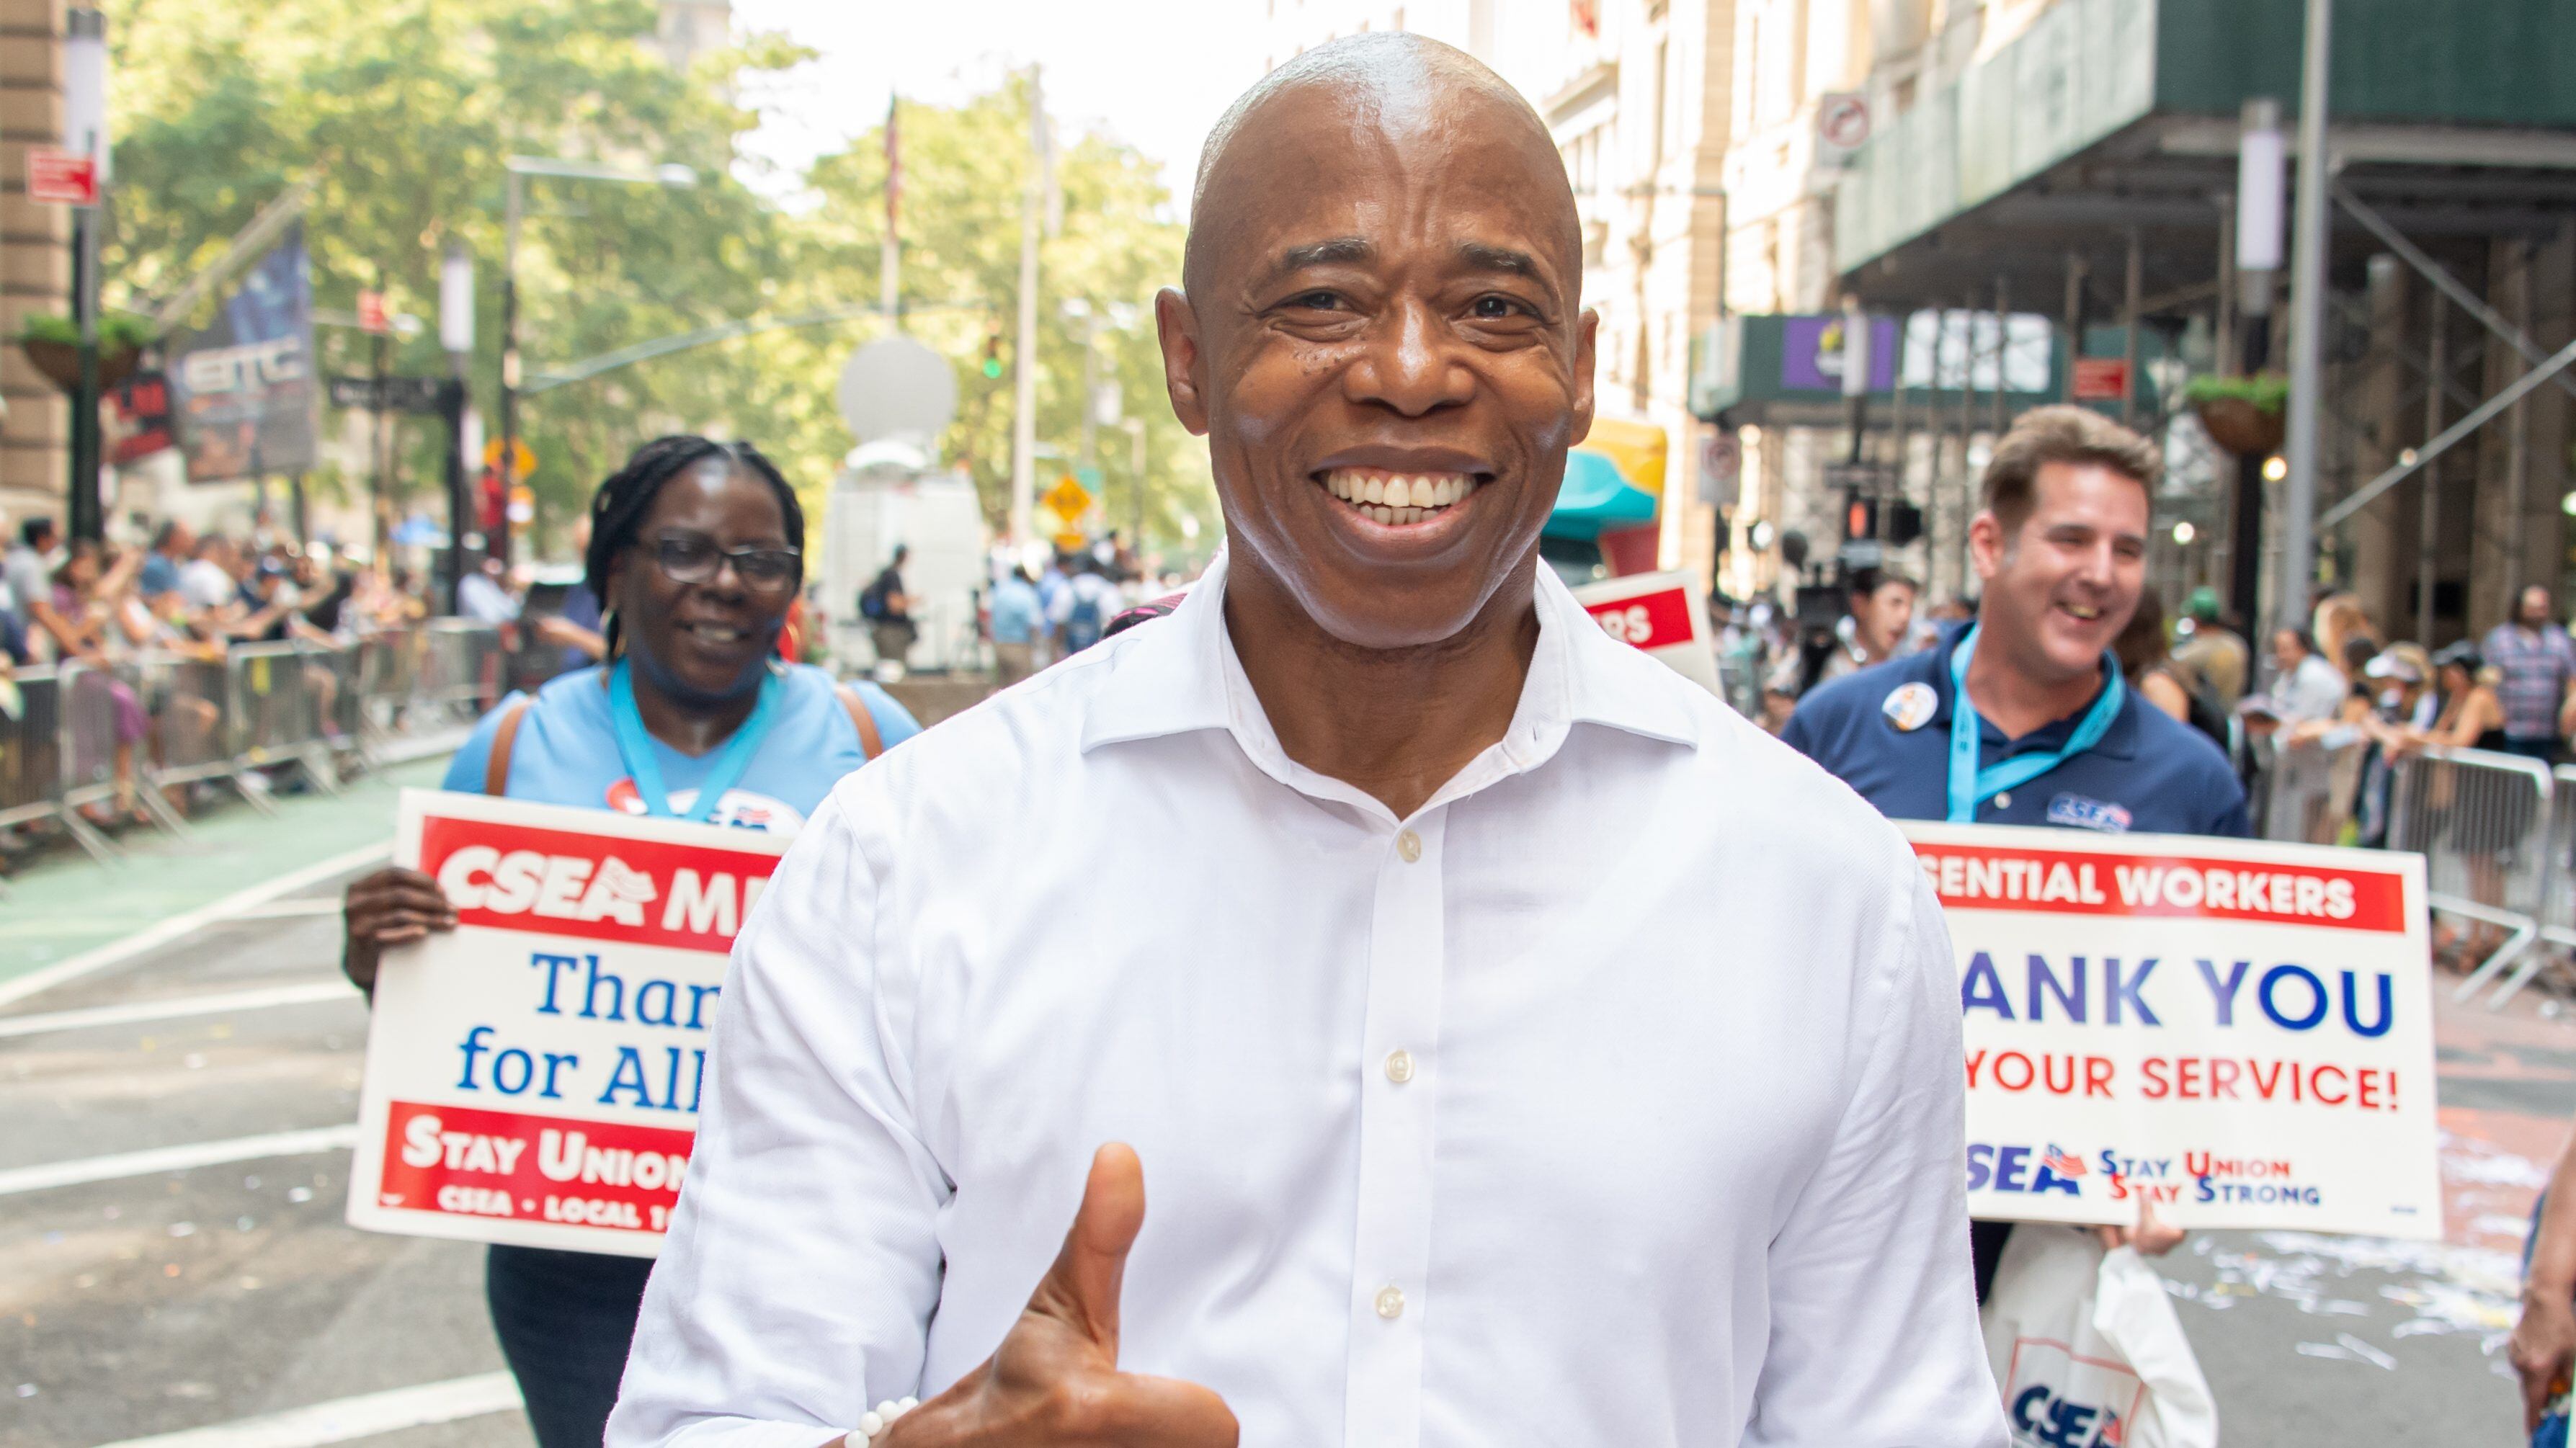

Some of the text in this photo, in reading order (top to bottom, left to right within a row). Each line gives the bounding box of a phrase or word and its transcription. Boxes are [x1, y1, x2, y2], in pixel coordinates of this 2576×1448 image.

[1591, 604, 1653, 643] RS
[437, 844, 647, 926] CSEA
[1916, 852, 2356, 920] SENTIAL WORKERS
[1961, 952, 2394, 1037] ANK YOU
[457, 1027, 707, 1113] for All
[1964, 1050, 2399, 1112] YOUR SERVICE!
[401, 1114, 527, 1174] STAY
[1967, 1143, 2081, 1196] SEA
[2099, 1149, 2291, 1178] STAY UNION
[437, 1185, 513, 1217] CSEA
[543, 1194, 642, 1228] LOCAL
[650, 1205, 675, 1230] 1
[2196, 1174, 2322, 1206] STRONG
